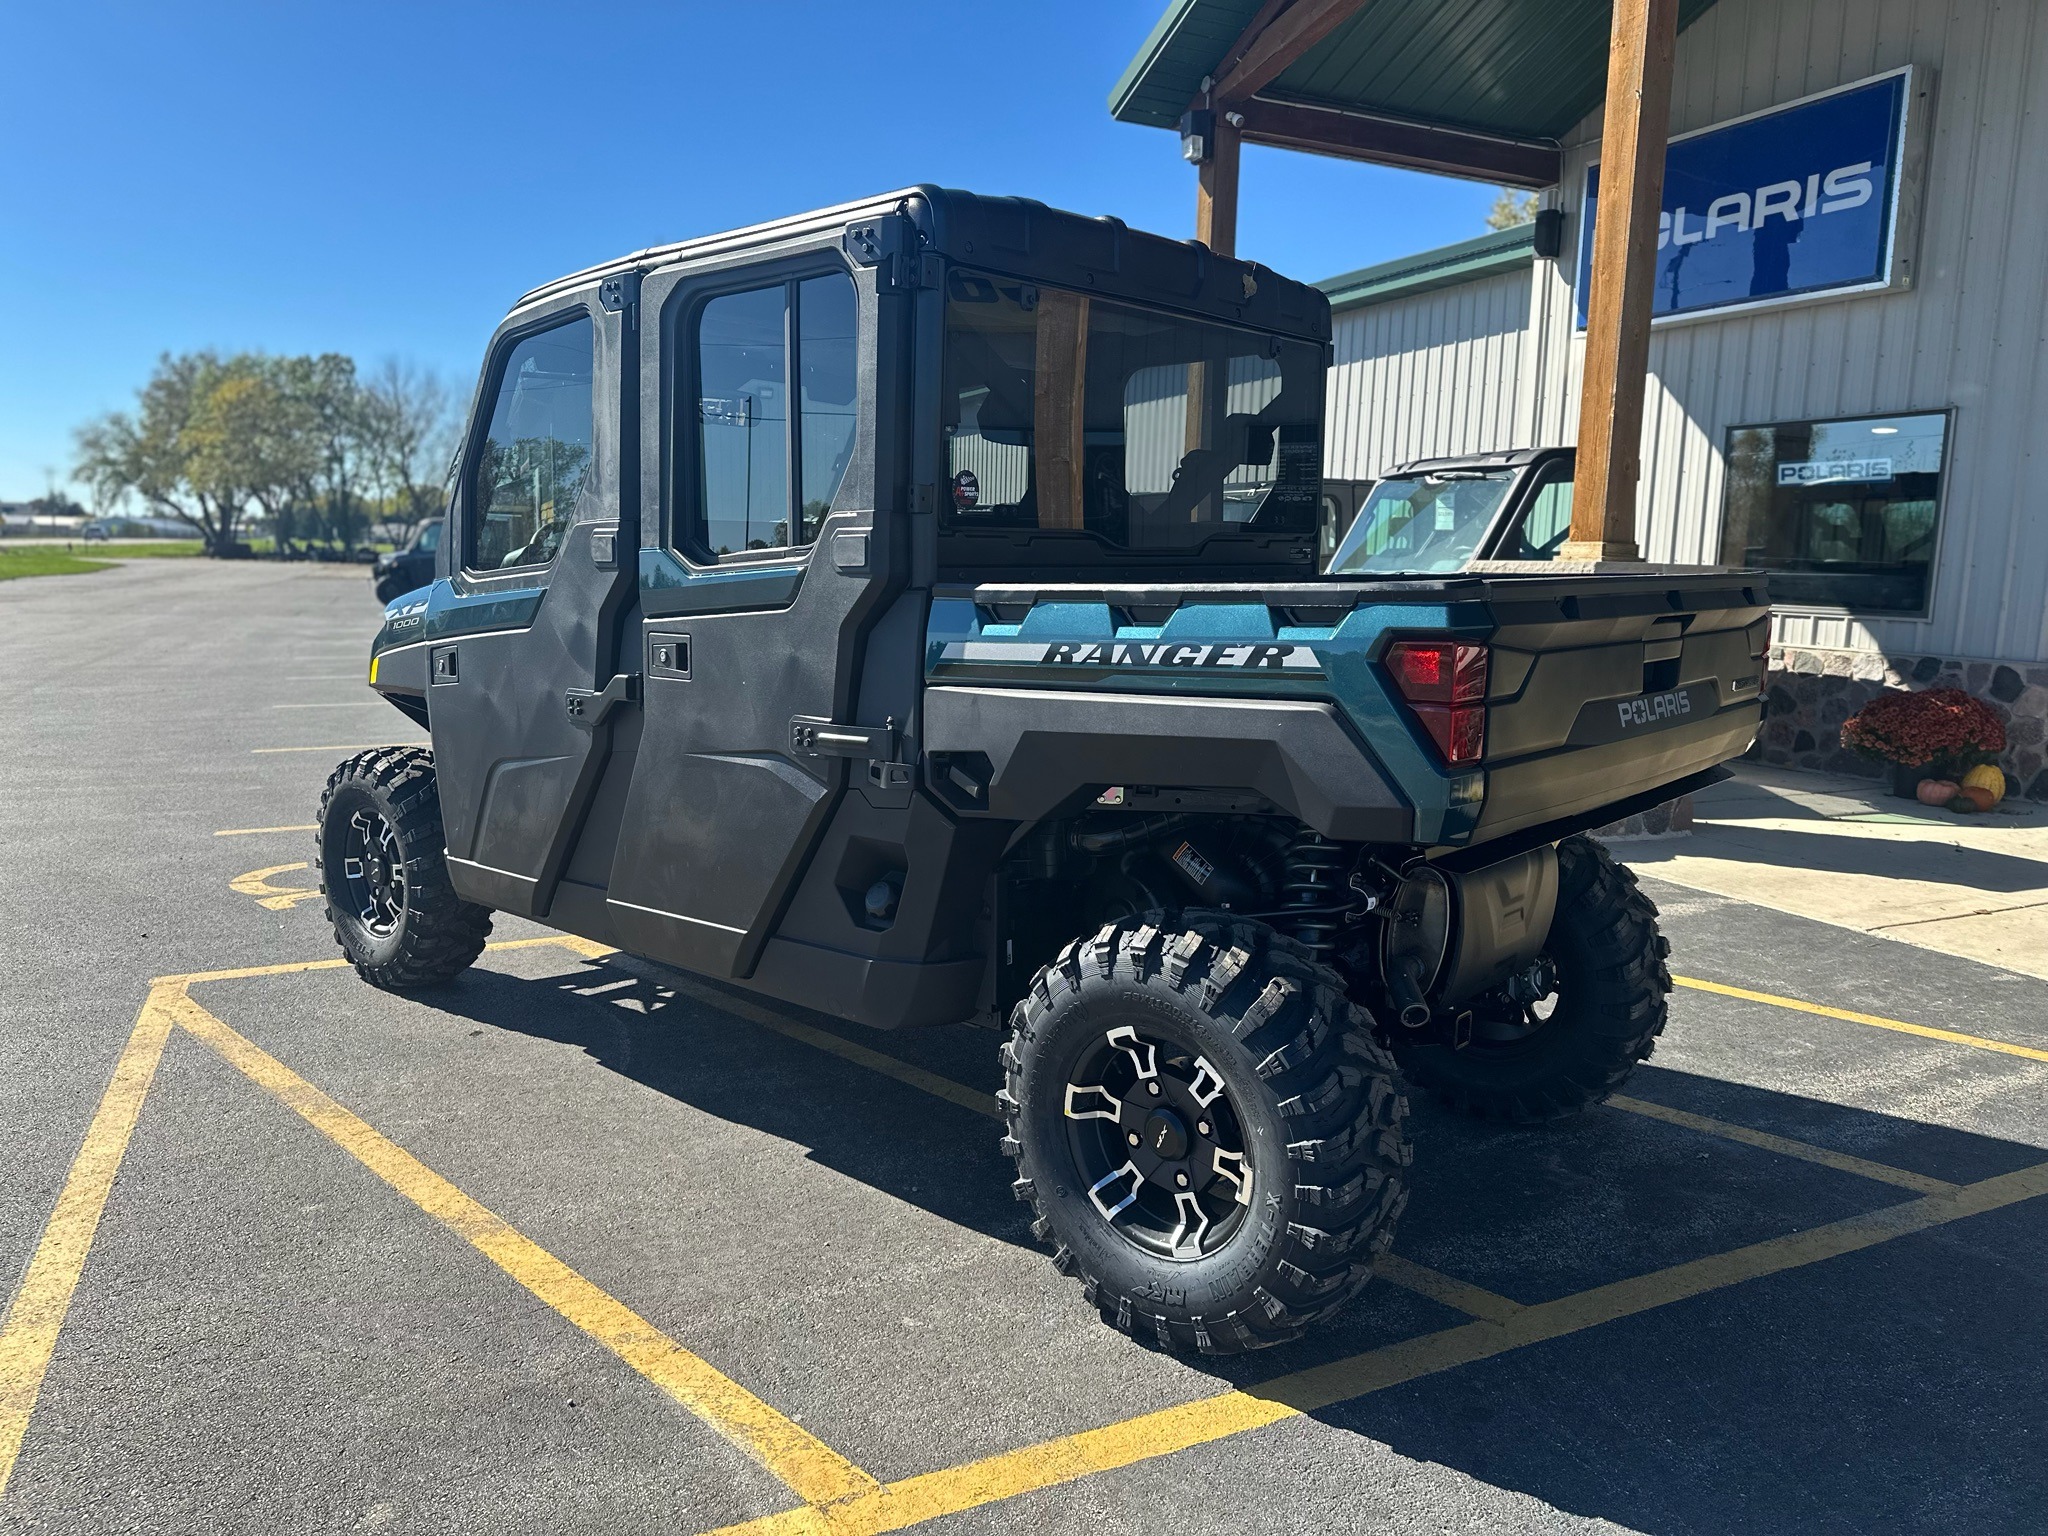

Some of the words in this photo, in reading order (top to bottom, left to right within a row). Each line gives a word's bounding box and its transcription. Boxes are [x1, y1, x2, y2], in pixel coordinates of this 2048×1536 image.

[1590, 161, 1873, 265] LARIS
[1780, 461, 1889, 481] POLARIS
[388, 598, 429, 619] XP
[392, 617, 420, 630] 1000
[1039, 640, 1296, 670] RANGER
[1617, 690, 1691, 728] POLARIS
[1208, 1190, 1284, 1304] X-TERRAIN
